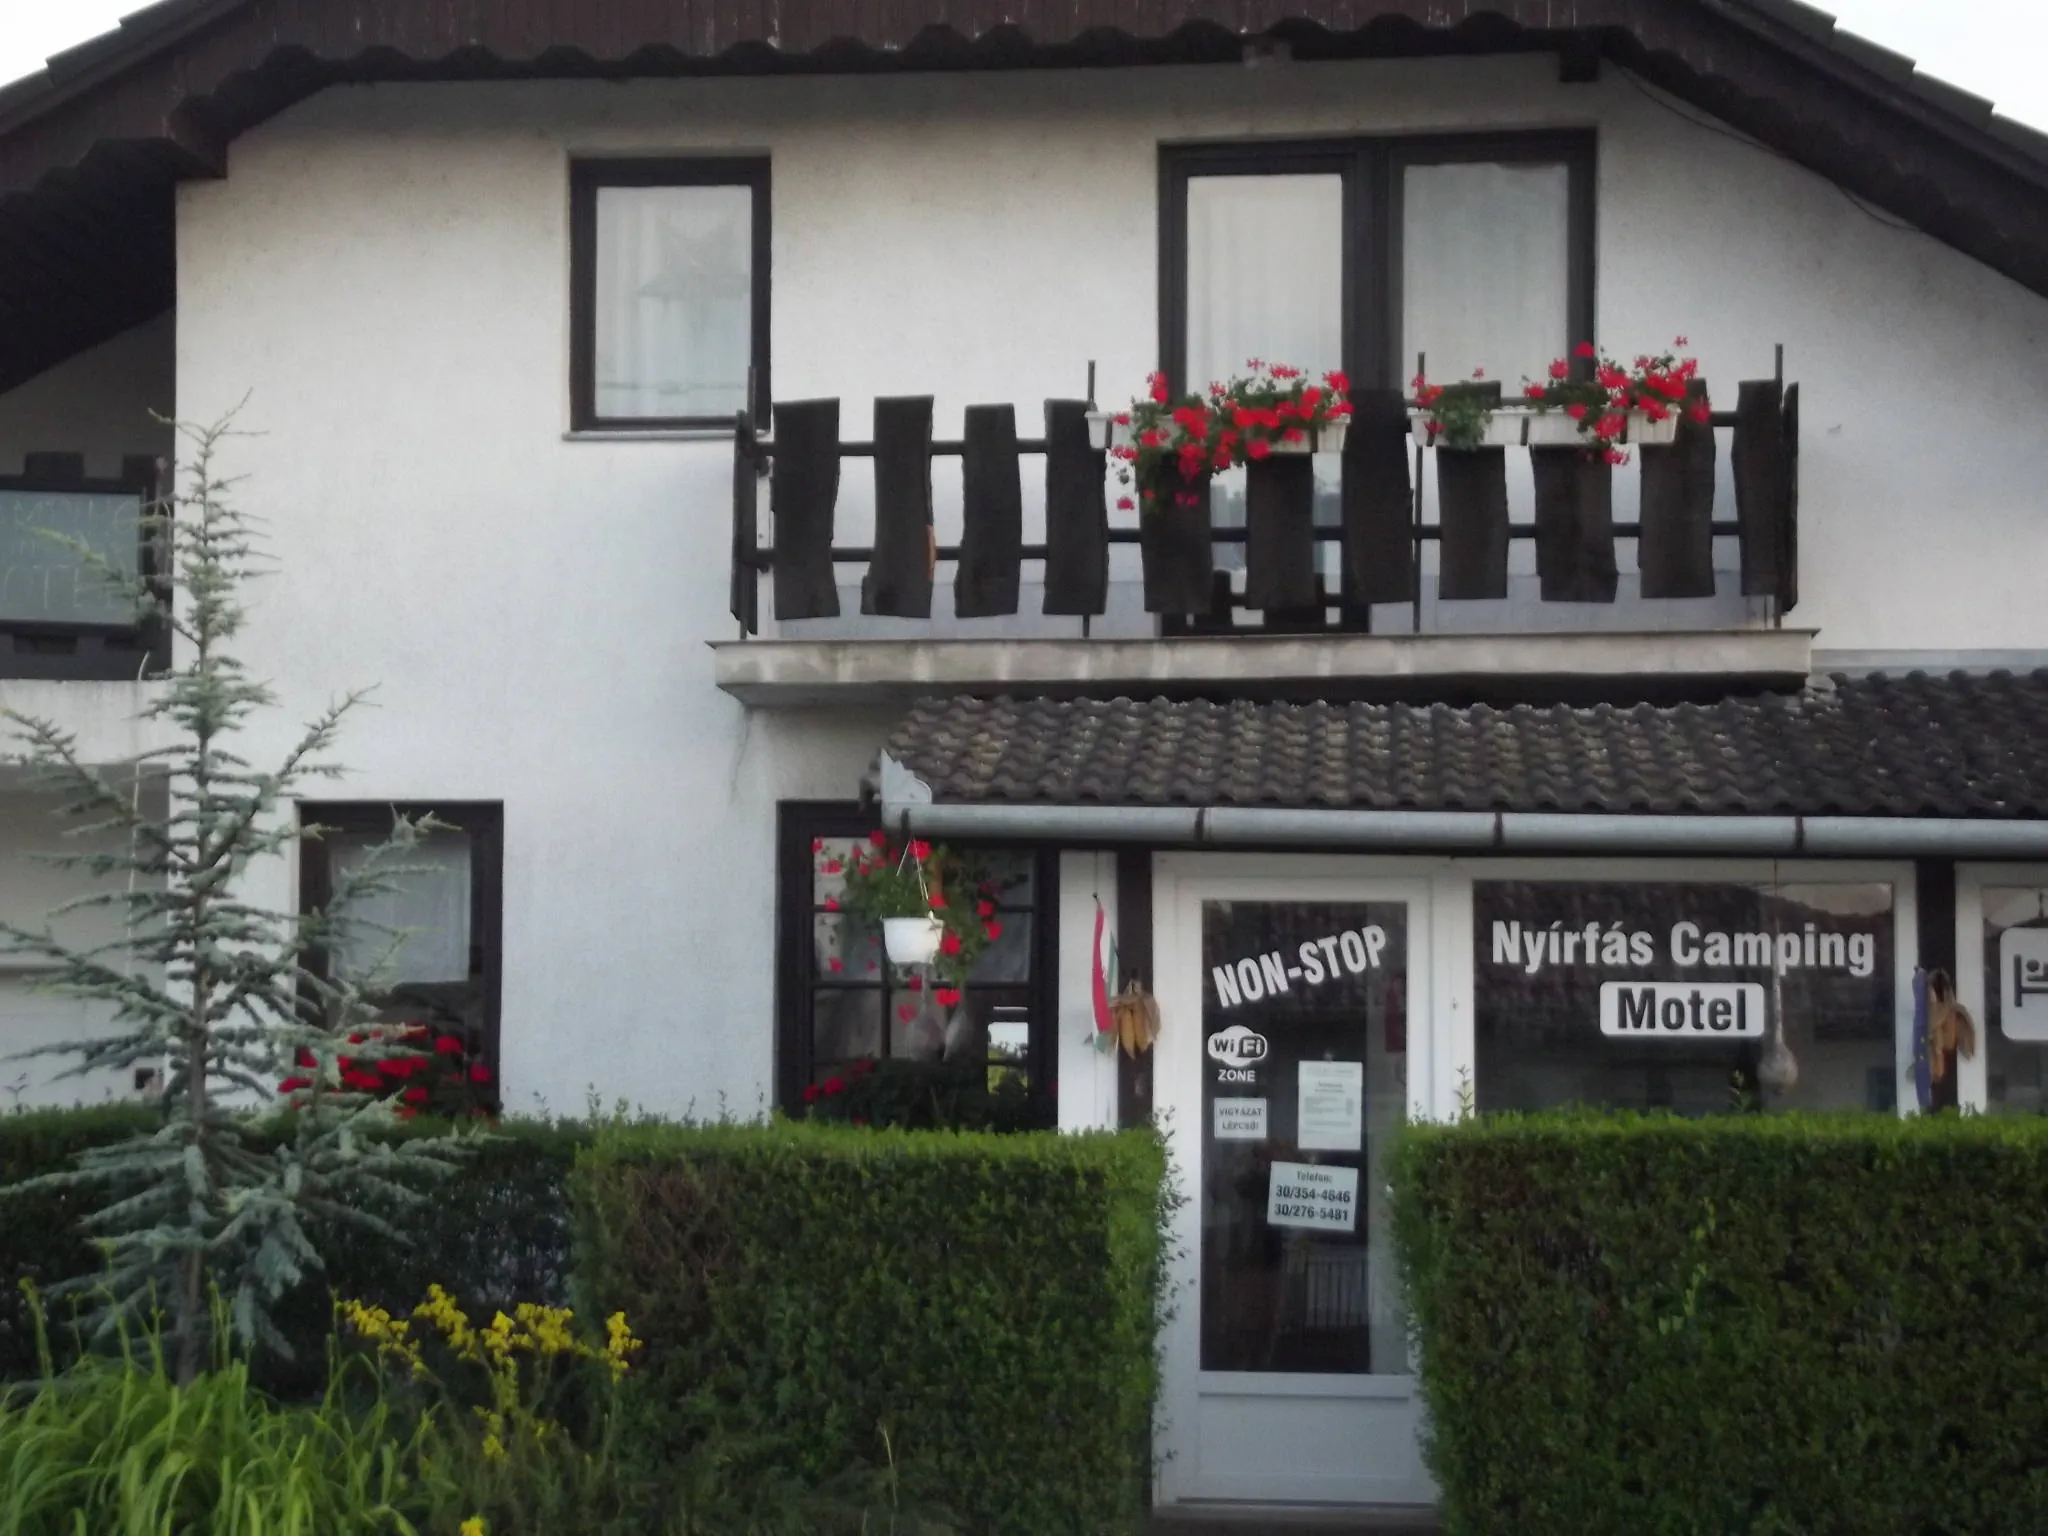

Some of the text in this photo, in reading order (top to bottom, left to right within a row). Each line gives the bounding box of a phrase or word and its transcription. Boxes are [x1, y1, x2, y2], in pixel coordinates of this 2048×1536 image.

[1212, 924, 1387, 1009] NON-STOP
[1491, 919, 1875, 977] Nyírfás Camping
[1616, 986, 1748, 1031] Motel
[1217, 1069, 1256, 1082] ZONE
